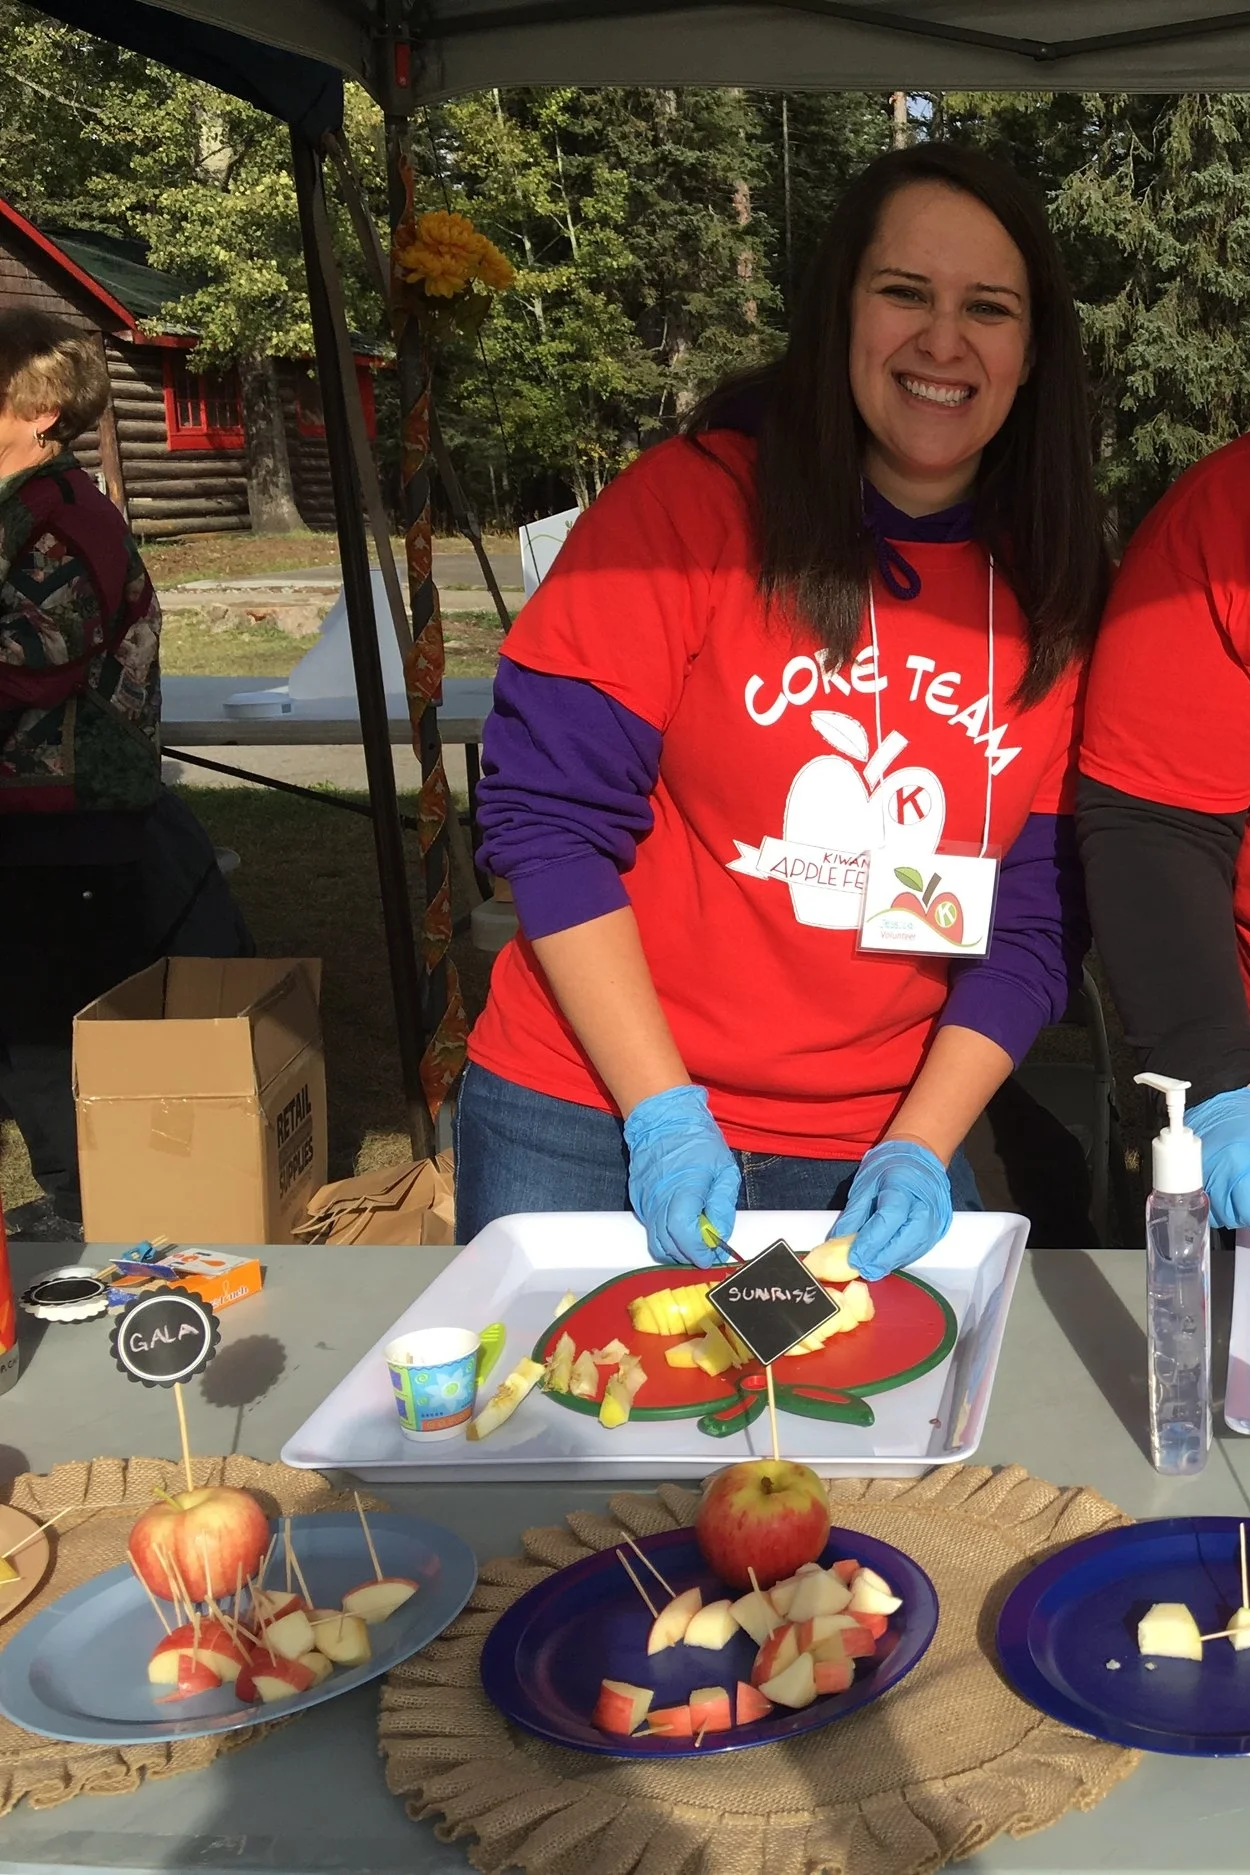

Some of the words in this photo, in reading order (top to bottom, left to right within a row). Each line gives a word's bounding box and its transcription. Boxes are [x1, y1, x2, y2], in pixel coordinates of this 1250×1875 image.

[744, 644, 889, 727] CORE
[905, 654, 1023, 777] TEAM
[895, 785, 925, 826] K
[880, 930, 917, 941] Volunteer
[277, 1083, 312, 1149] RETAIL
[279, 1135, 314, 1200] SUPPLIES
[728, 1285, 817, 1305] SUNRISE
[129, 1323, 200, 1353] GALA
